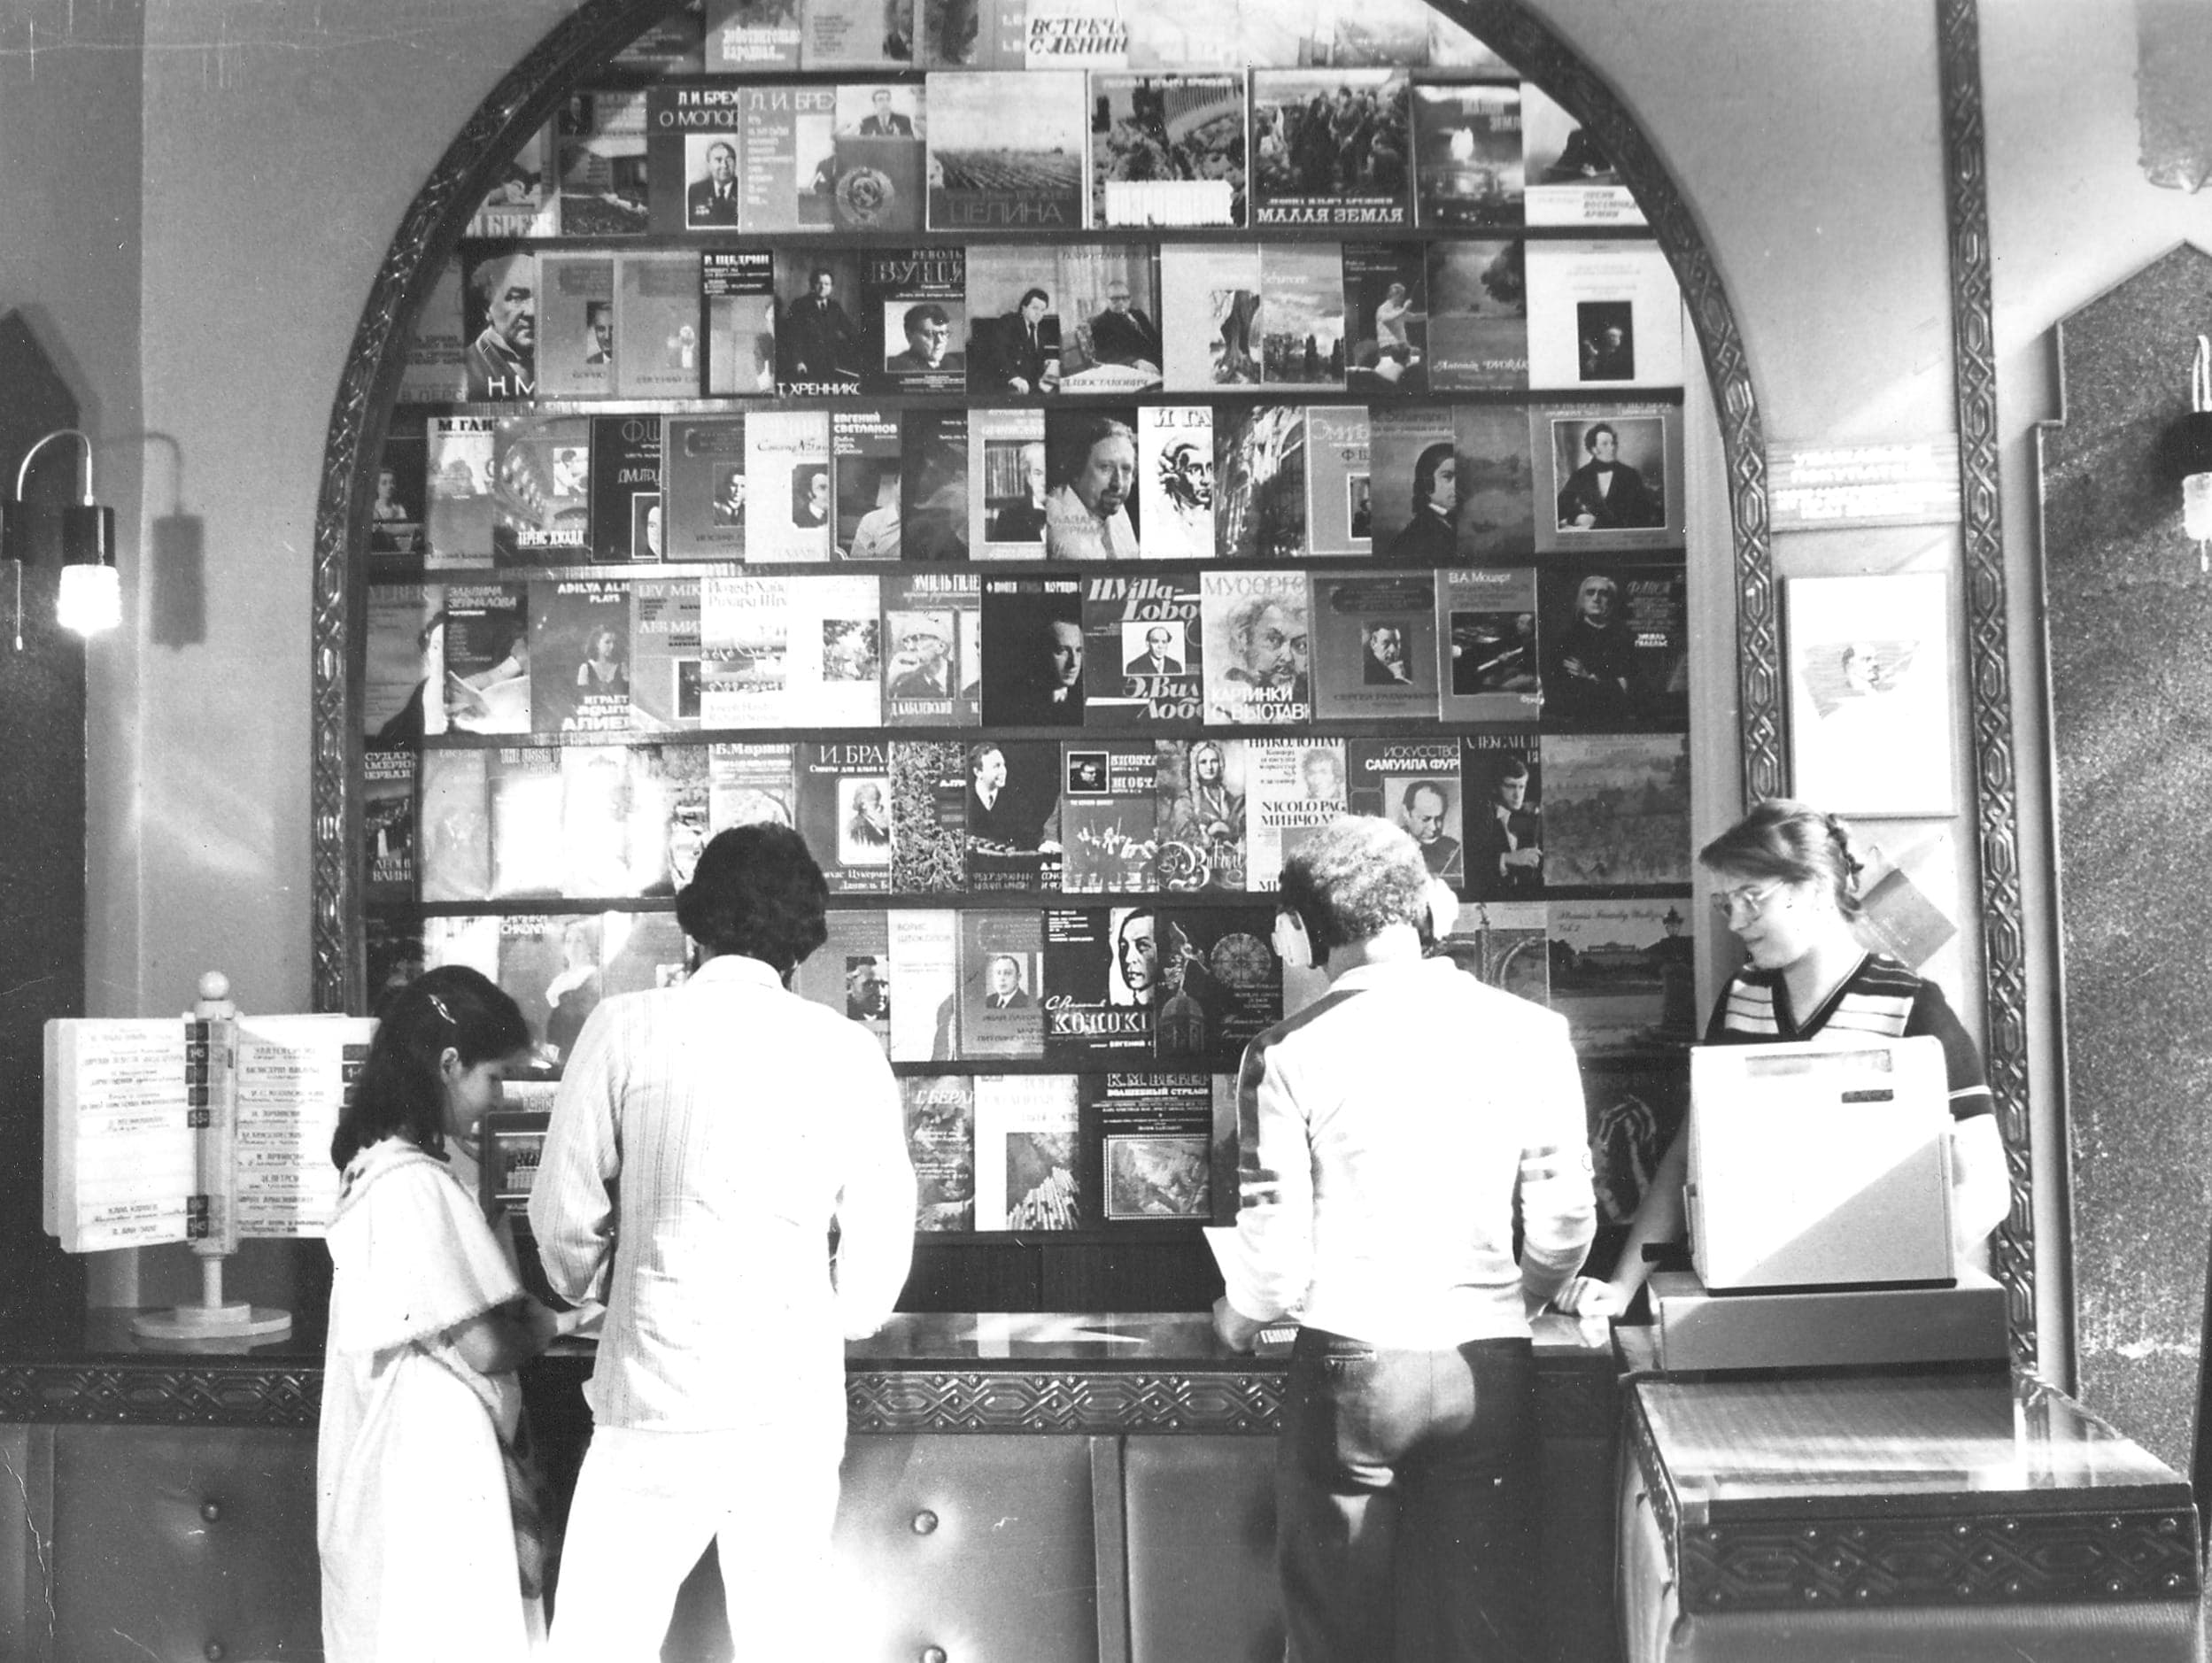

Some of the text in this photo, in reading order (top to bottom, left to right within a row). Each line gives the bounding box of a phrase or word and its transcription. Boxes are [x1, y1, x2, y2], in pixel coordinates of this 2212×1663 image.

[949, 202, 1065, 223] ЦЕЛИНА
[1256, 208, 1404, 223] МАЛАЯ ЗЕМЛЯ
[833, 411, 881, 423] ЕВГЕНИЙ
[1181, 410, 1213, 427] ГА
[833, 424, 898, 434] СВЕТЛАНОВ
[557, 582, 600, 595] ADILYA
[1122, 599, 1201, 622] Lobo
[1210, 685, 1293, 703] КАРТИНКИ
[846, 742, 889, 763] БРА
[1365, 758, 1427, 771] САМУИЛА
[1262, 801, 1318, 813] NICOLO
